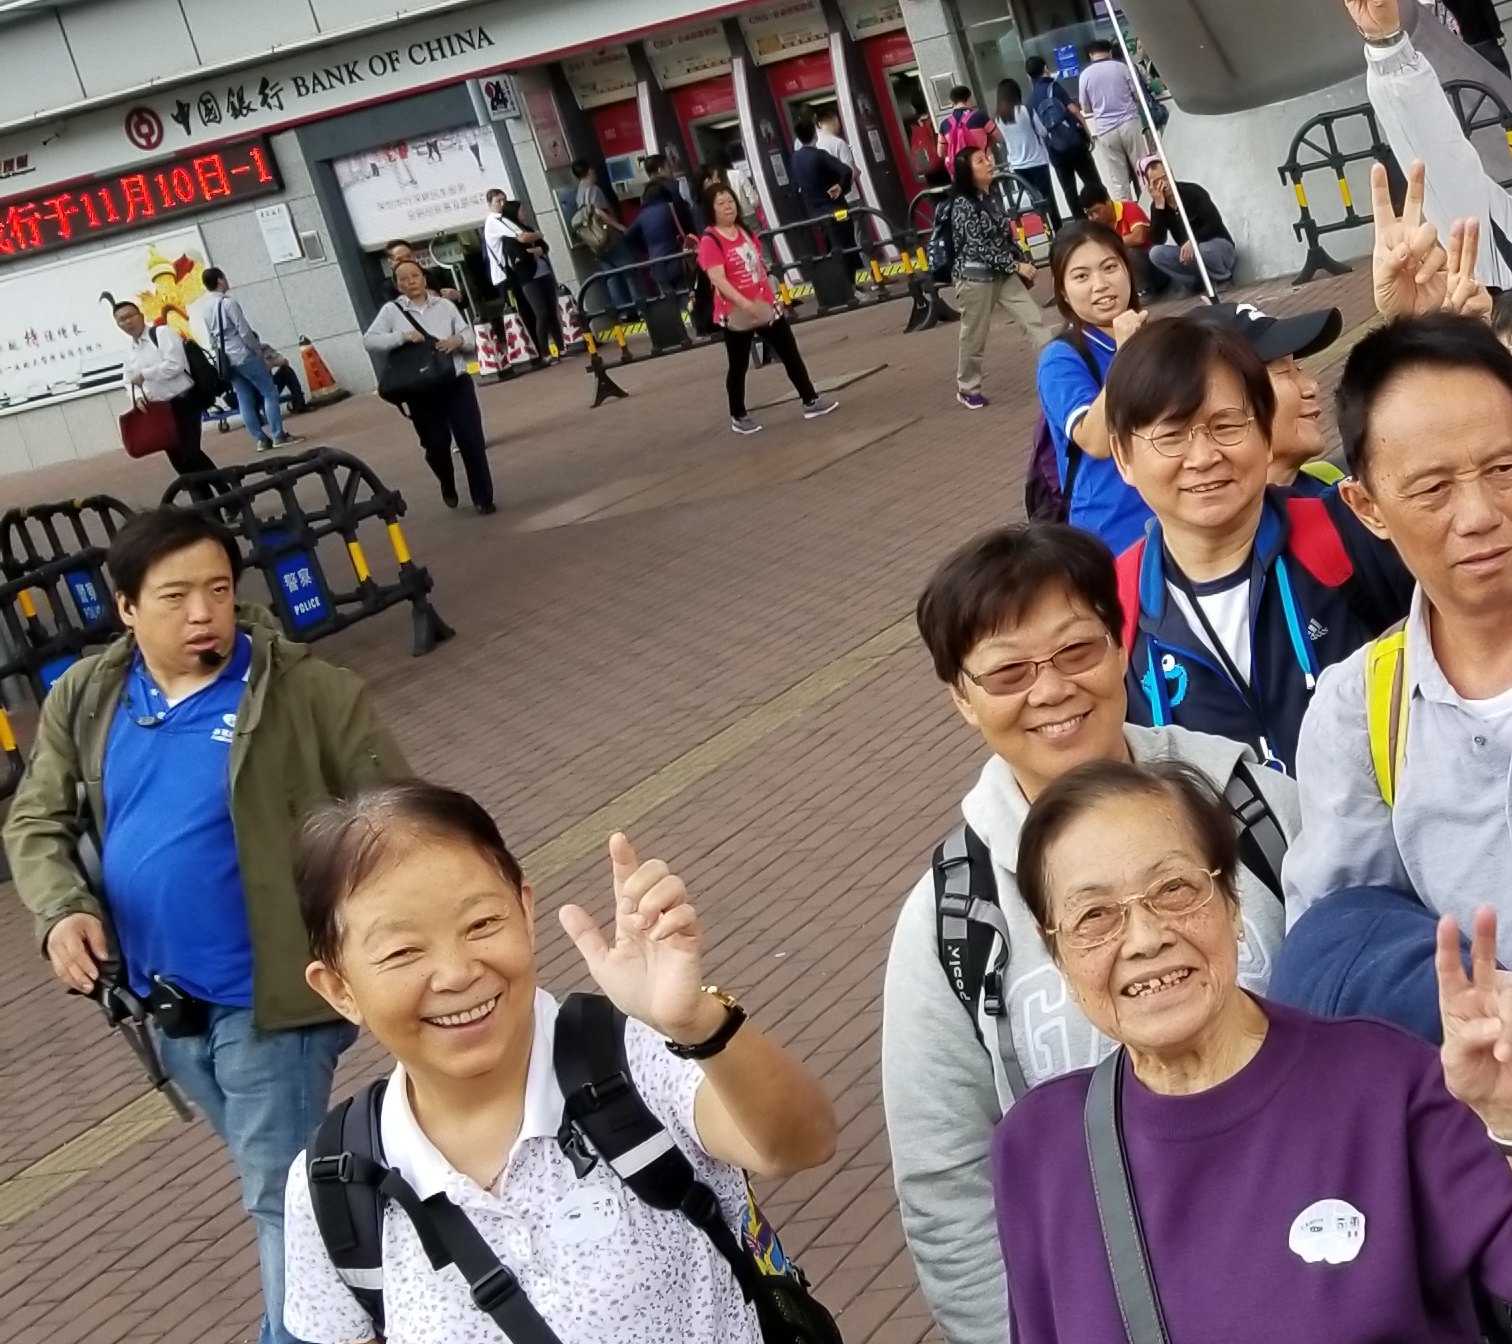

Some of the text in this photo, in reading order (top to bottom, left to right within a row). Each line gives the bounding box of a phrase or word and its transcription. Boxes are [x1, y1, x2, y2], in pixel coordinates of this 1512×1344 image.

[170, 25, 496, 136] 中國銀行 BANK OF CHINA
[0, 146, 273, 255] 行于11月10日-1
[283, 567, 313, 594] 警察
[294, 596, 321, 616] POLICE
